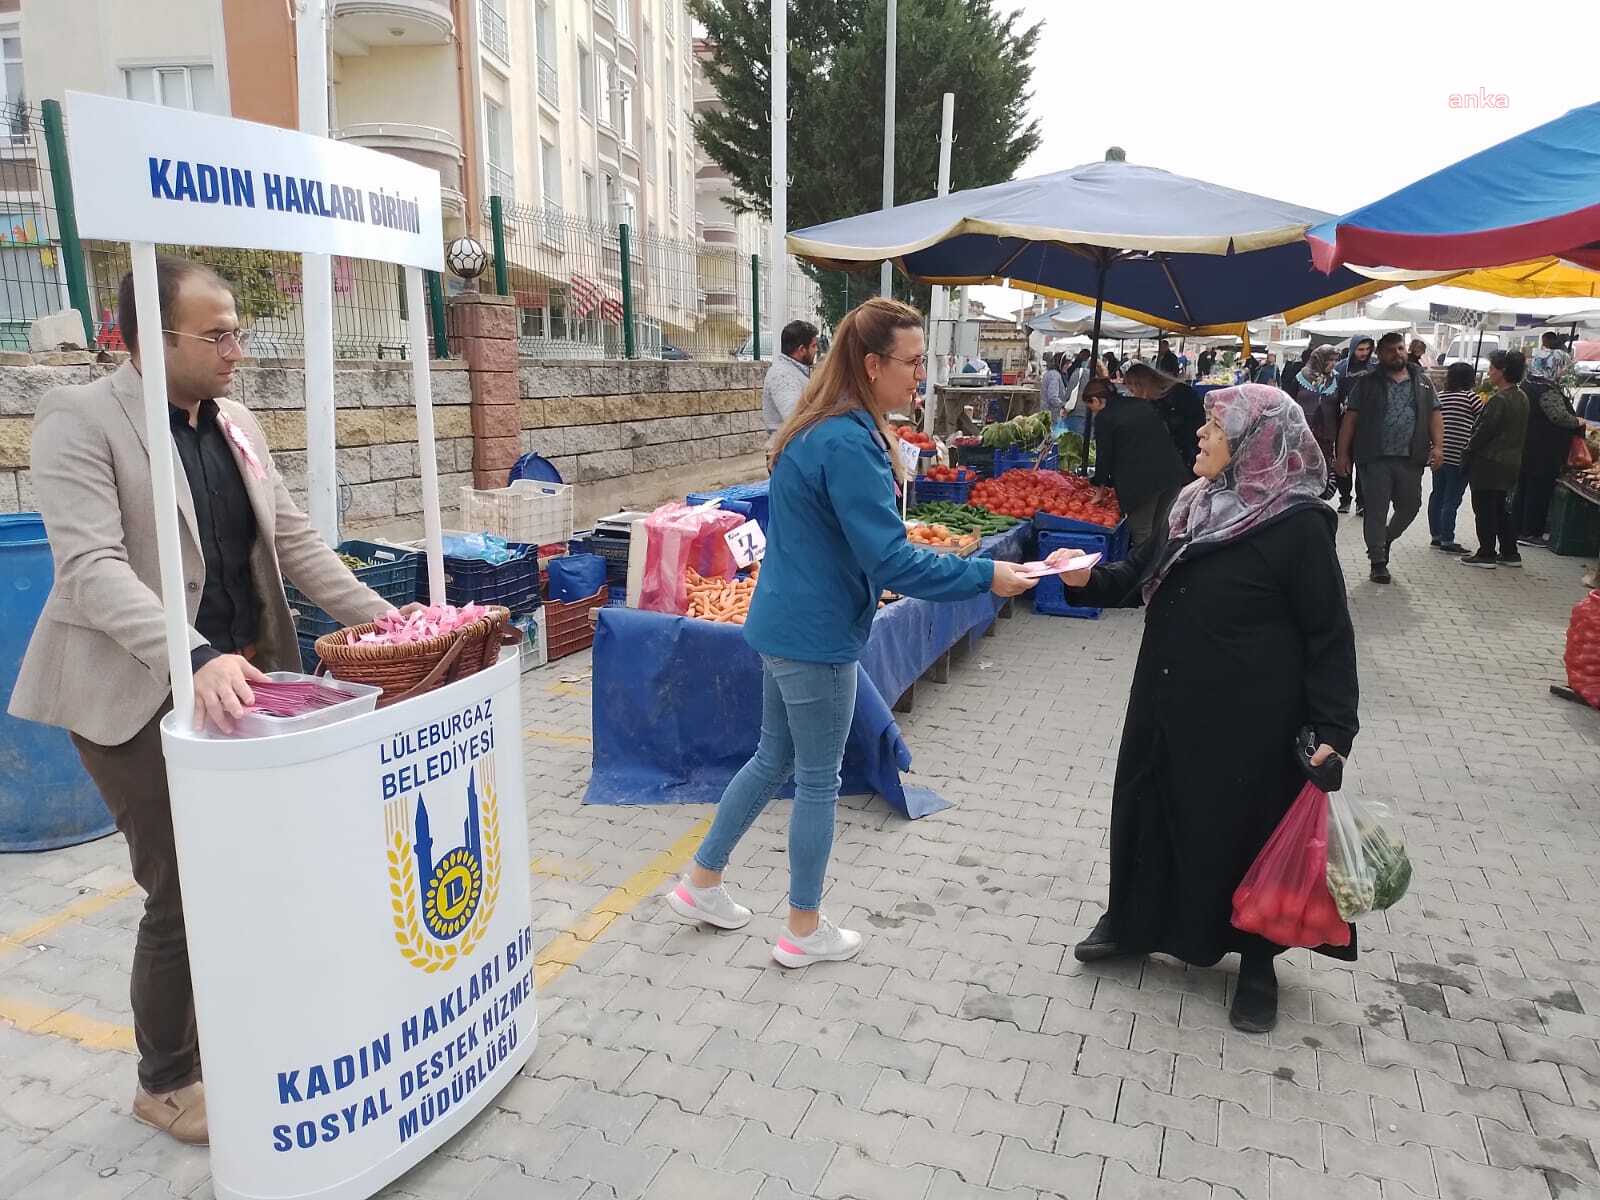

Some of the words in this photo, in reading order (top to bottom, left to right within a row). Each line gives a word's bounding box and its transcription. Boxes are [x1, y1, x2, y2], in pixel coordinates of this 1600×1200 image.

[149, 157, 256, 208] KADIN
[263, 172, 366, 223] HAKLARI
[368, 187, 421, 234] BİRİMİ
[380, 698, 493, 764] LÜLEBURGAZ
[382, 721, 494, 800] BELEDİYESİ
[277, 1032, 392, 1104] KADIN
[401, 954, 501, 1052] HAKLARI
[273, 1087, 393, 1152] SOSYAL
[399, 1021, 480, 1101] DESTEK
[398, 1020, 518, 1143] MÜDÜRLÜĞÜ
